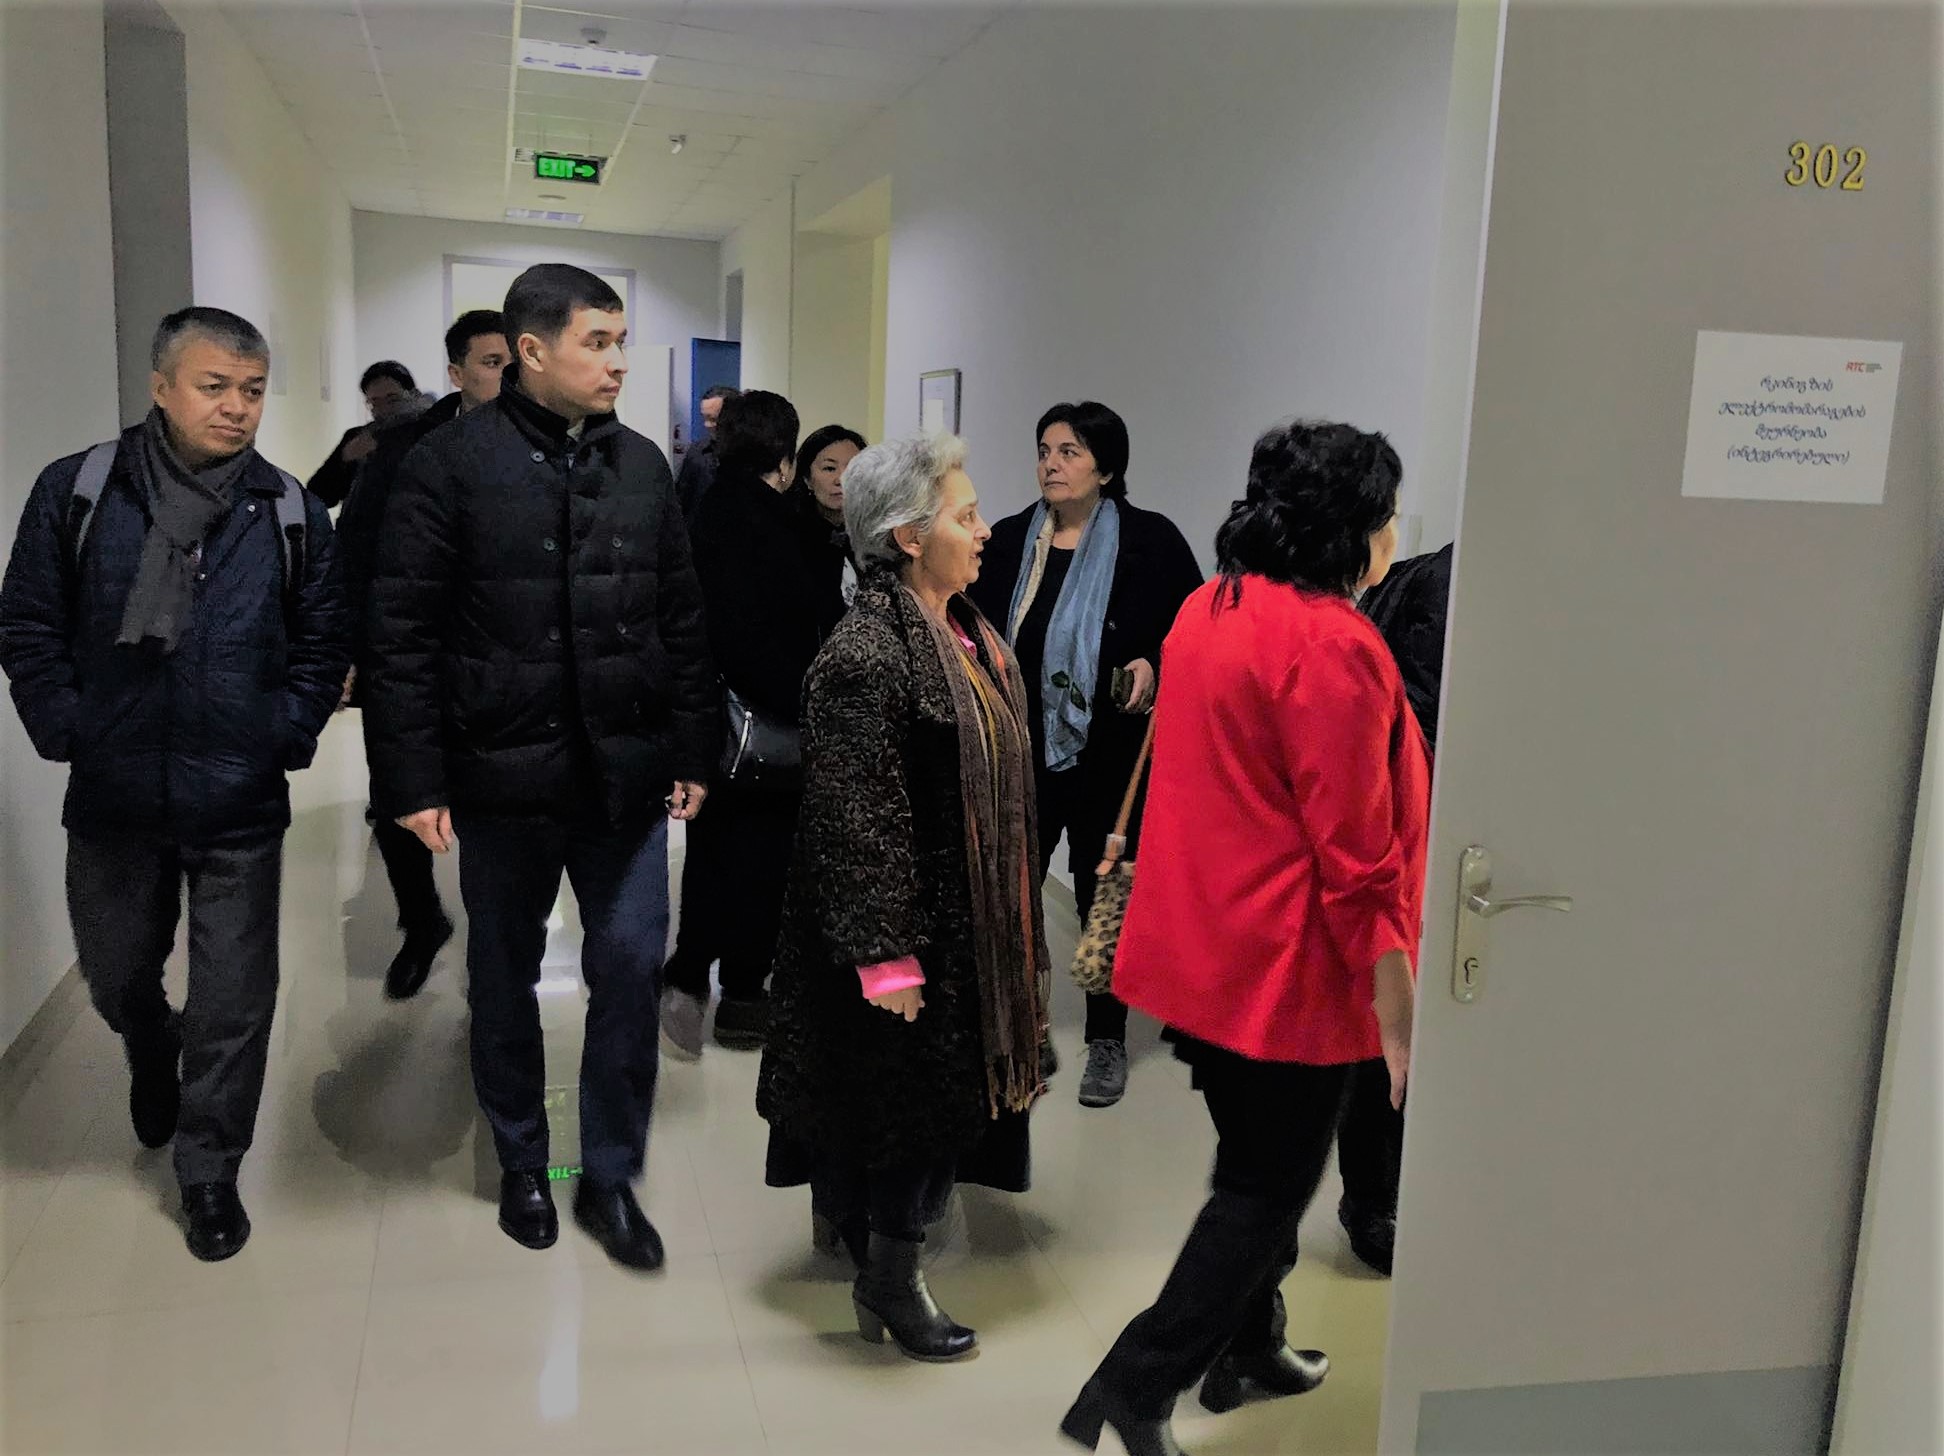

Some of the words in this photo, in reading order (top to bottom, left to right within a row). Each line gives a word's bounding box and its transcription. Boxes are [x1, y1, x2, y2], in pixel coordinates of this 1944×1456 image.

[538, 158, 576, 178] EXIT
[1785, 141, 1867, 191] 302
[1845, 361, 1865, 373] RTC
